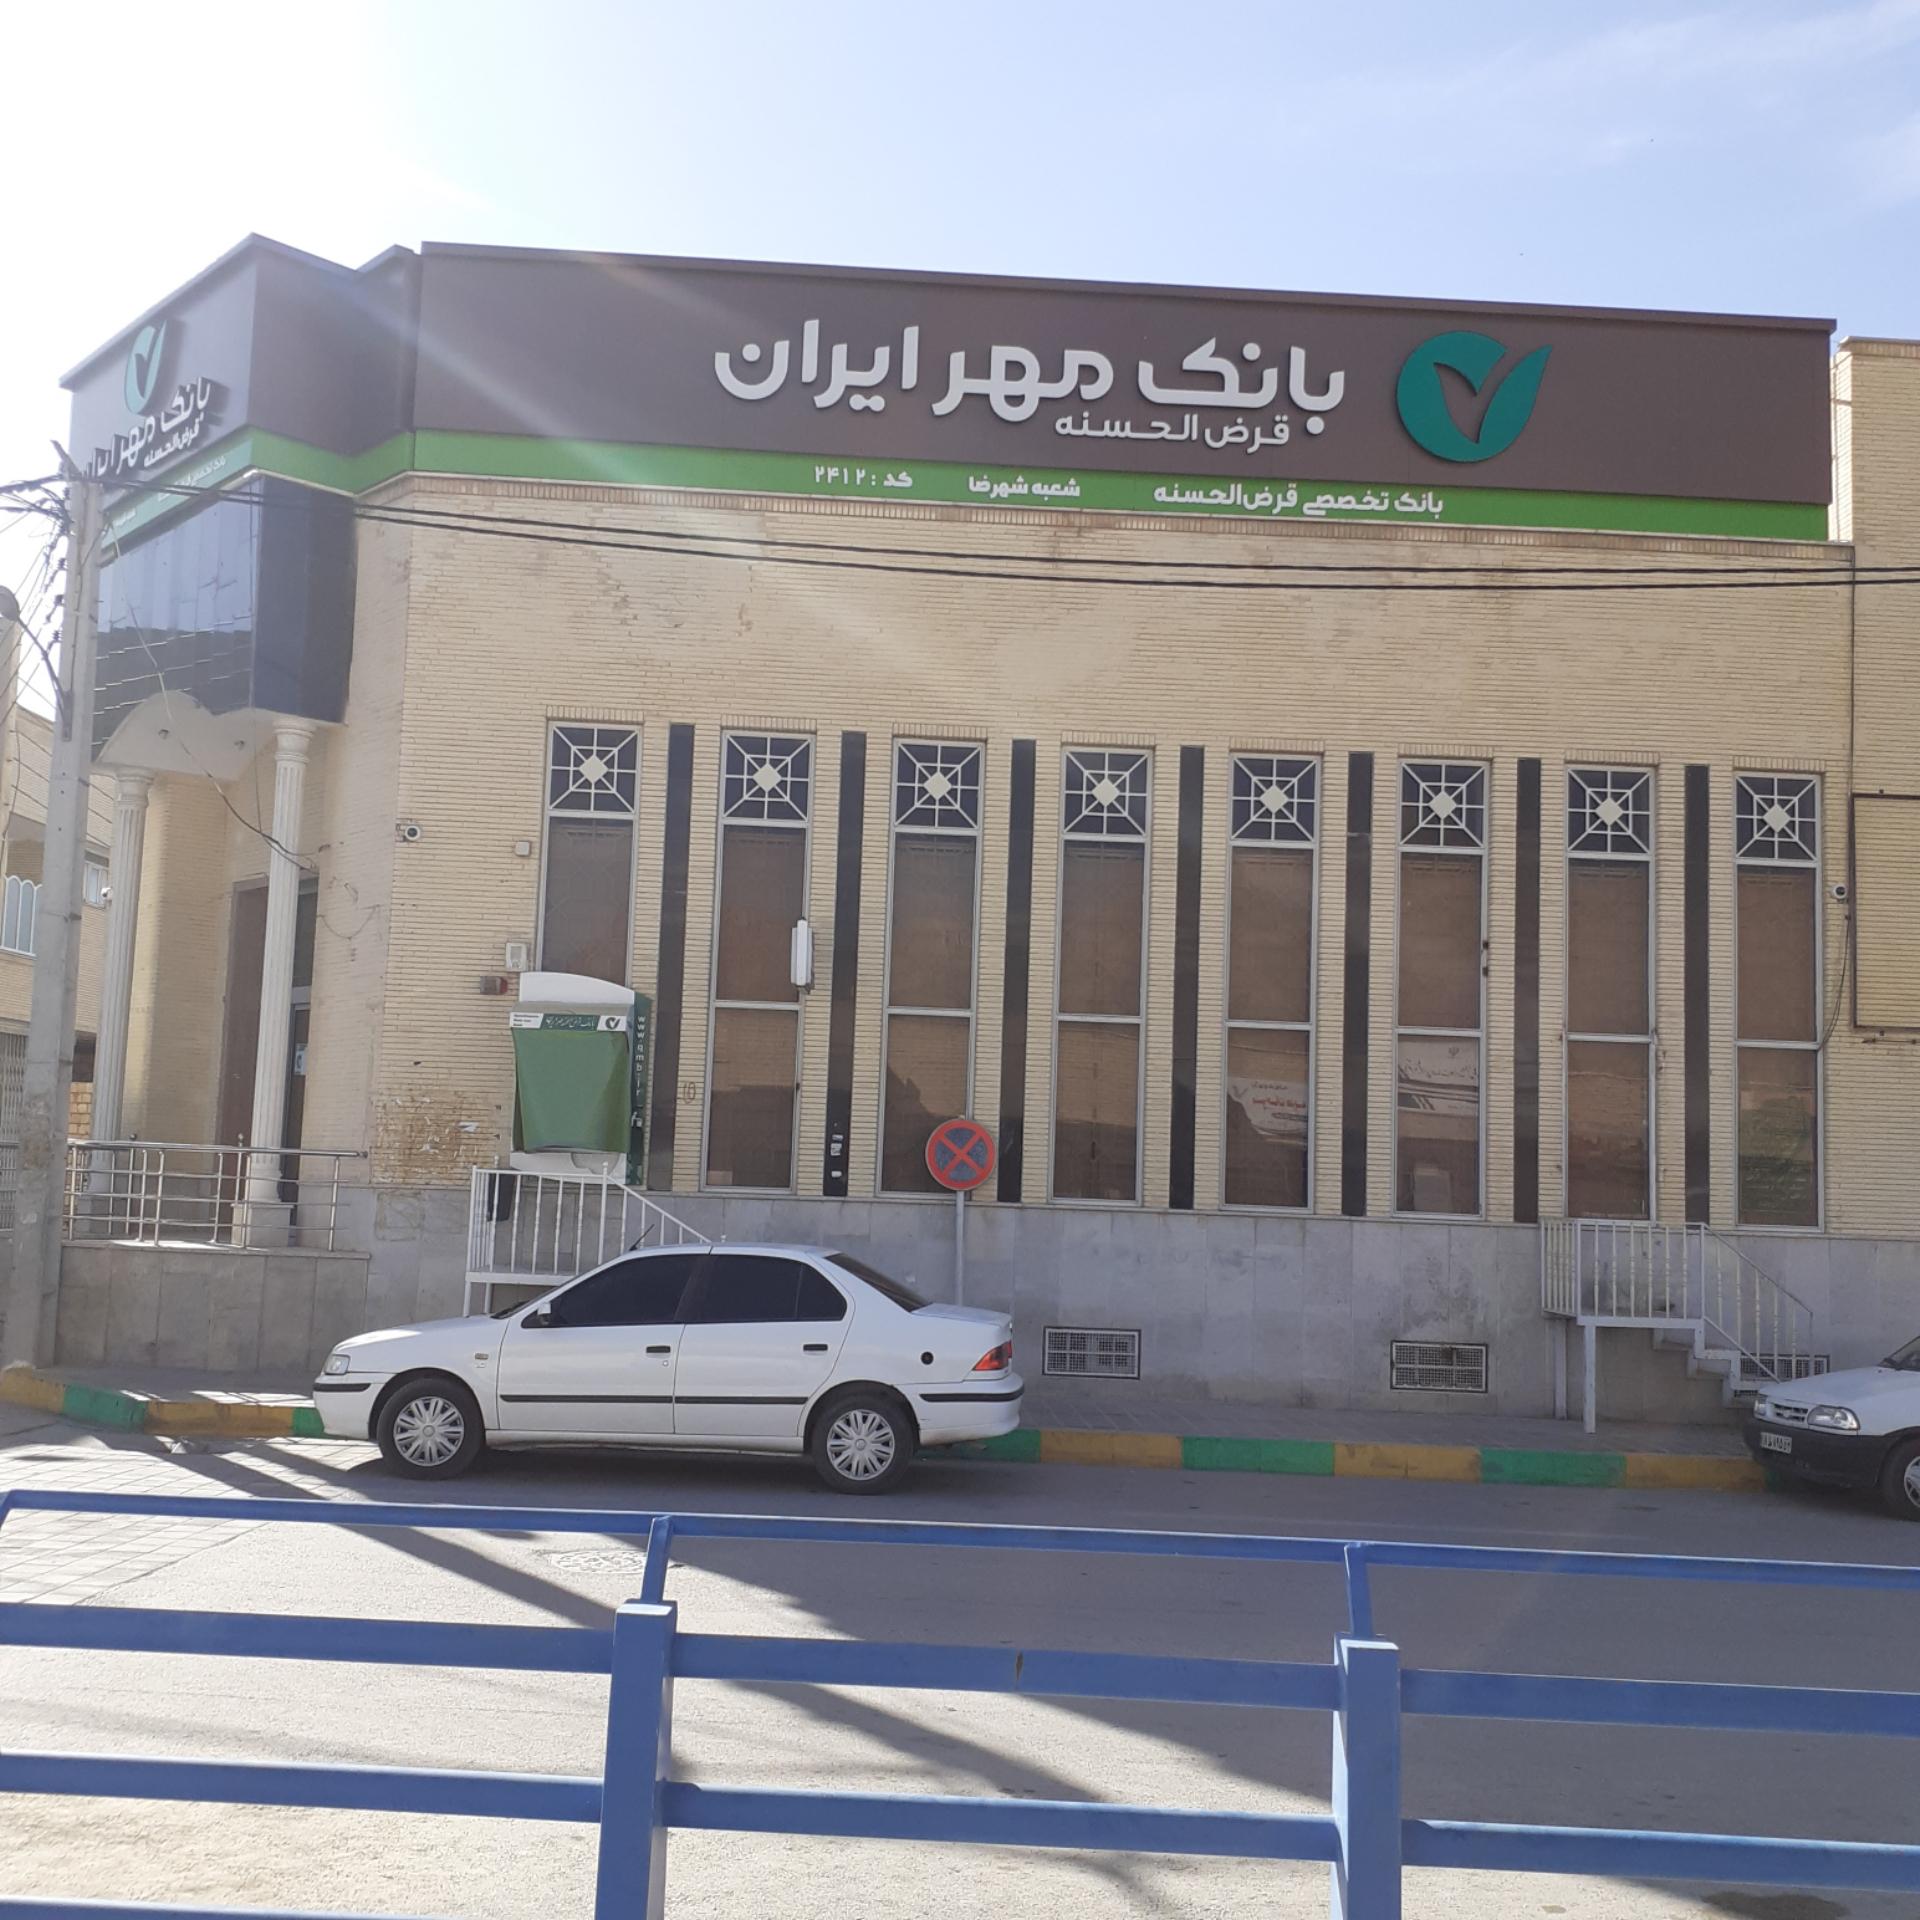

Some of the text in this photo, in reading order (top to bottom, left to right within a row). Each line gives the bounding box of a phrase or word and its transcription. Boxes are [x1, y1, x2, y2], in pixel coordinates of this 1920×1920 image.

[714, 319, 1345, 436] بانک مهر ایران
[161, 376, 211, 433] بانک
[116, 415, 156, 475] مهر
[1055, 410, 1290, 454] قرض الحسنه
[814, 464, 866, 486] ۲۴۱۲
[968, 474, 1081, 501] شعبه شهرضا
[1302, 488, 1389, 516] تخصصی
[1393, 490, 1443, 520] بانک
